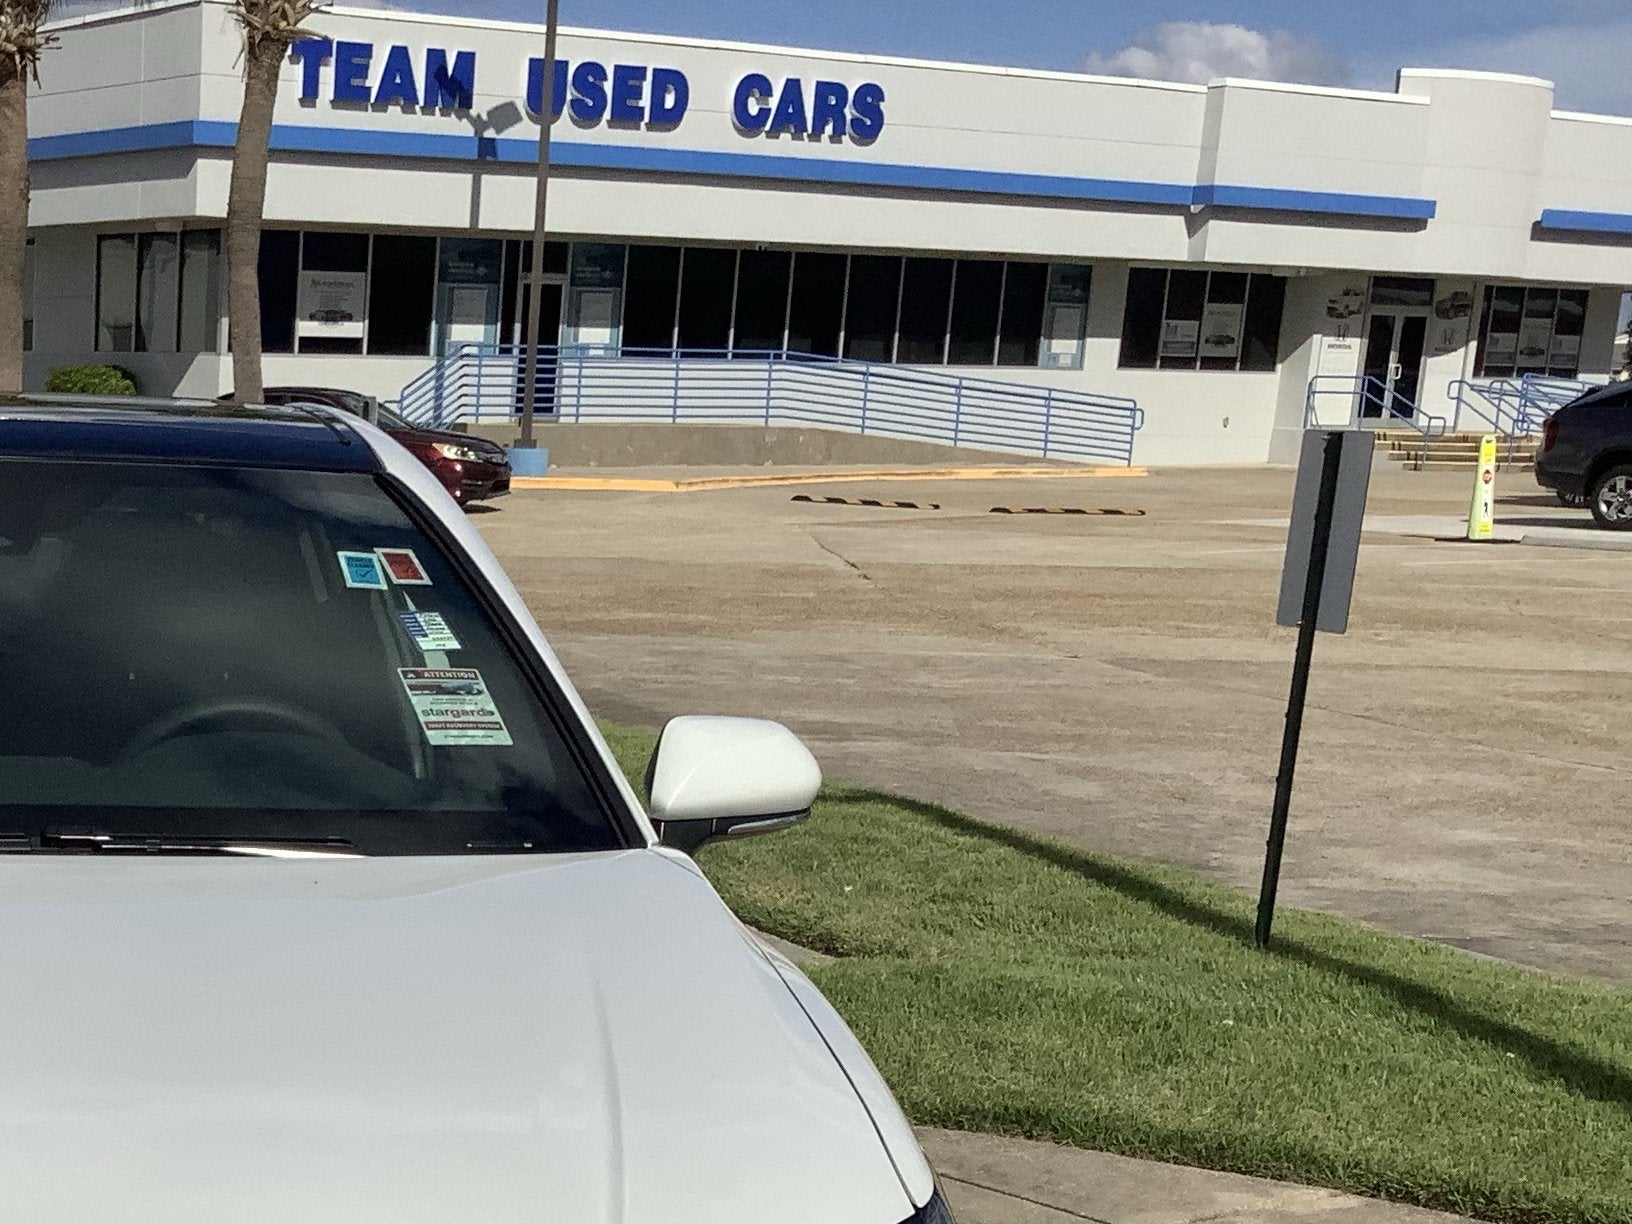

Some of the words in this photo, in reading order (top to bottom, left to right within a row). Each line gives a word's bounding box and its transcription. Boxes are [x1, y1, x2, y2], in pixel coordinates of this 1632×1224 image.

[289, 37, 476, 112] TEAM
[525, 57, 690, 129] USED
[733, 72, 886, 142] CARS
[424, 671, 476, 679] ATTENTION
